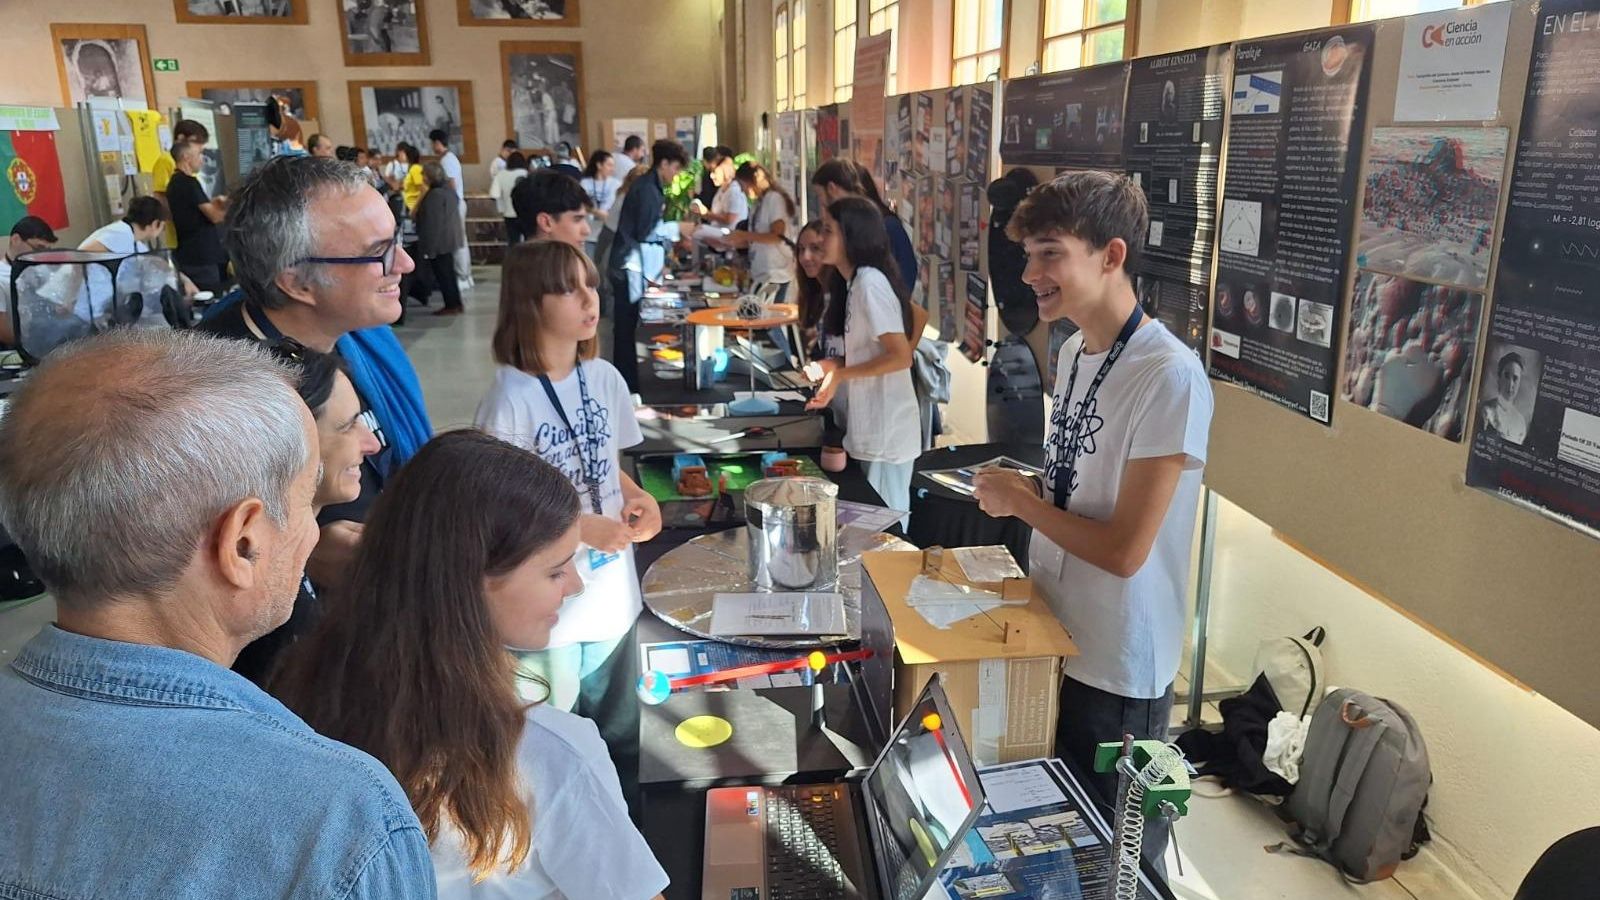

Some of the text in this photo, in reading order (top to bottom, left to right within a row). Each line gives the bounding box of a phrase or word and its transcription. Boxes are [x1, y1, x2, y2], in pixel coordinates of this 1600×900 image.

[1446, 20, 1478, 34] Ciencia
[1543, 14, 1567, 35] EN
[1570, 11, 1591, 32] EL
[1445, 32, 1482, 47] en acción
[1552, 214, 1561, 223] M
[1587, 217, 1600, 230] log
